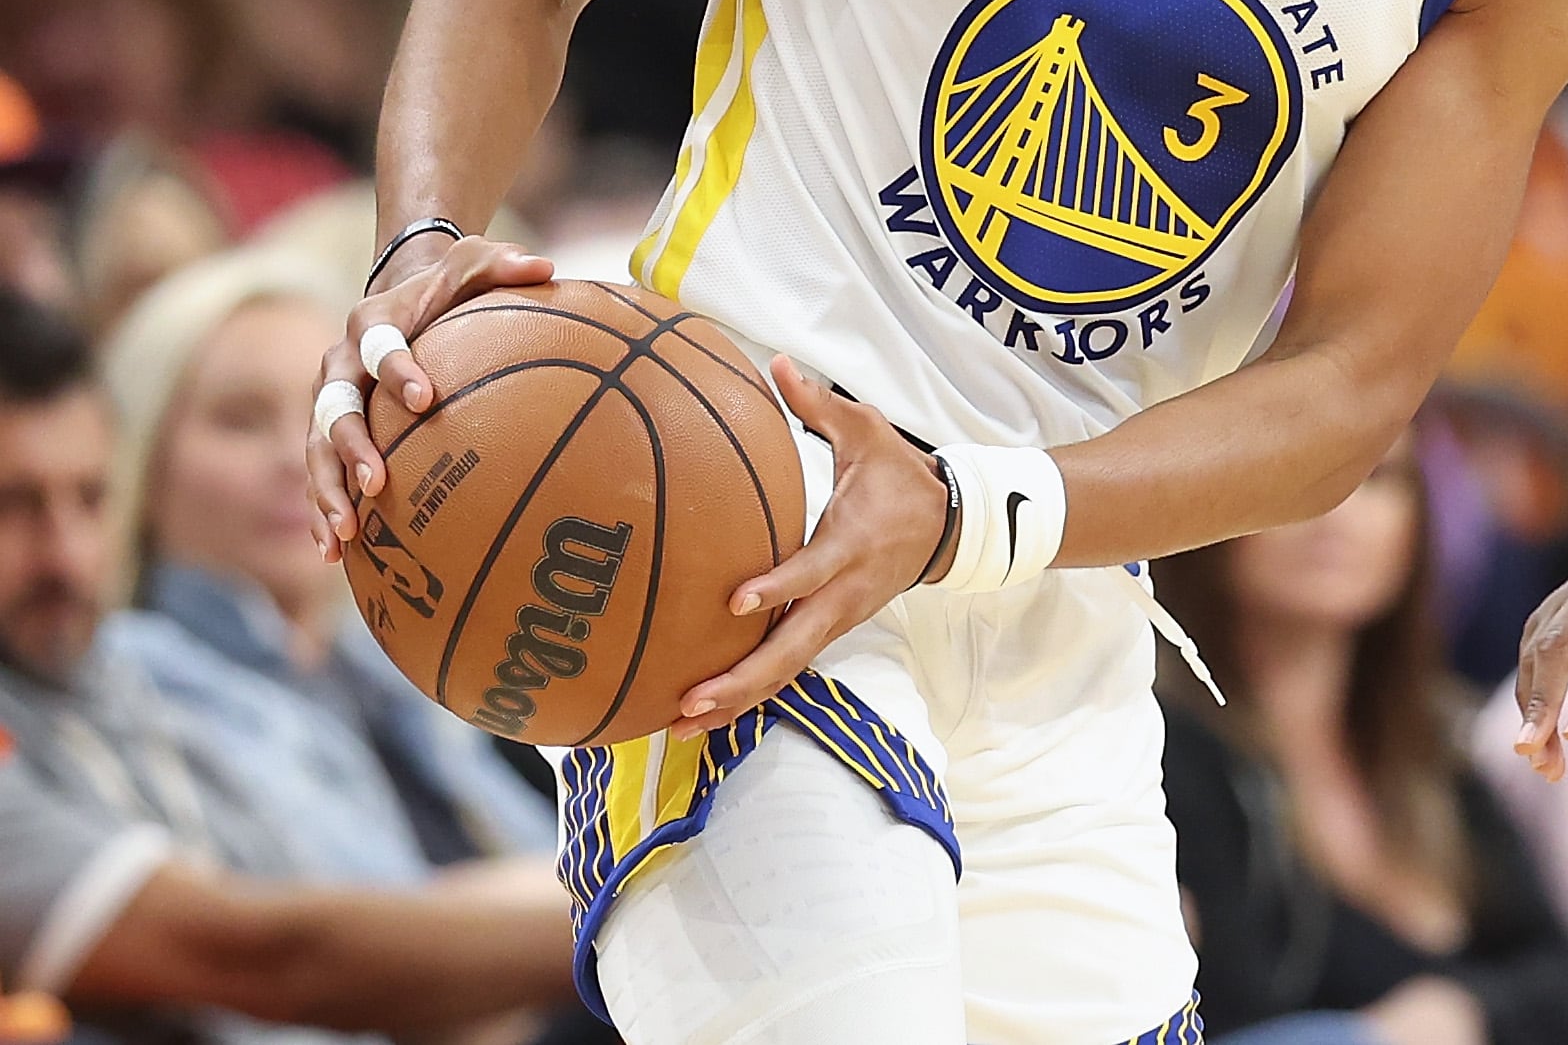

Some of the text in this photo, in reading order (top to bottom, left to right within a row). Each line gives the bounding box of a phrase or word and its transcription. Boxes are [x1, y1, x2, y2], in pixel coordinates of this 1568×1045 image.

[1164, 73, 1250, 162] 3
[440, 448, 481, 492] OFFICIAL
[408, 509, 431, 537] BALL
[421, 485, 449, 518] GAME
[468, 515, 634, 735] Wilson
